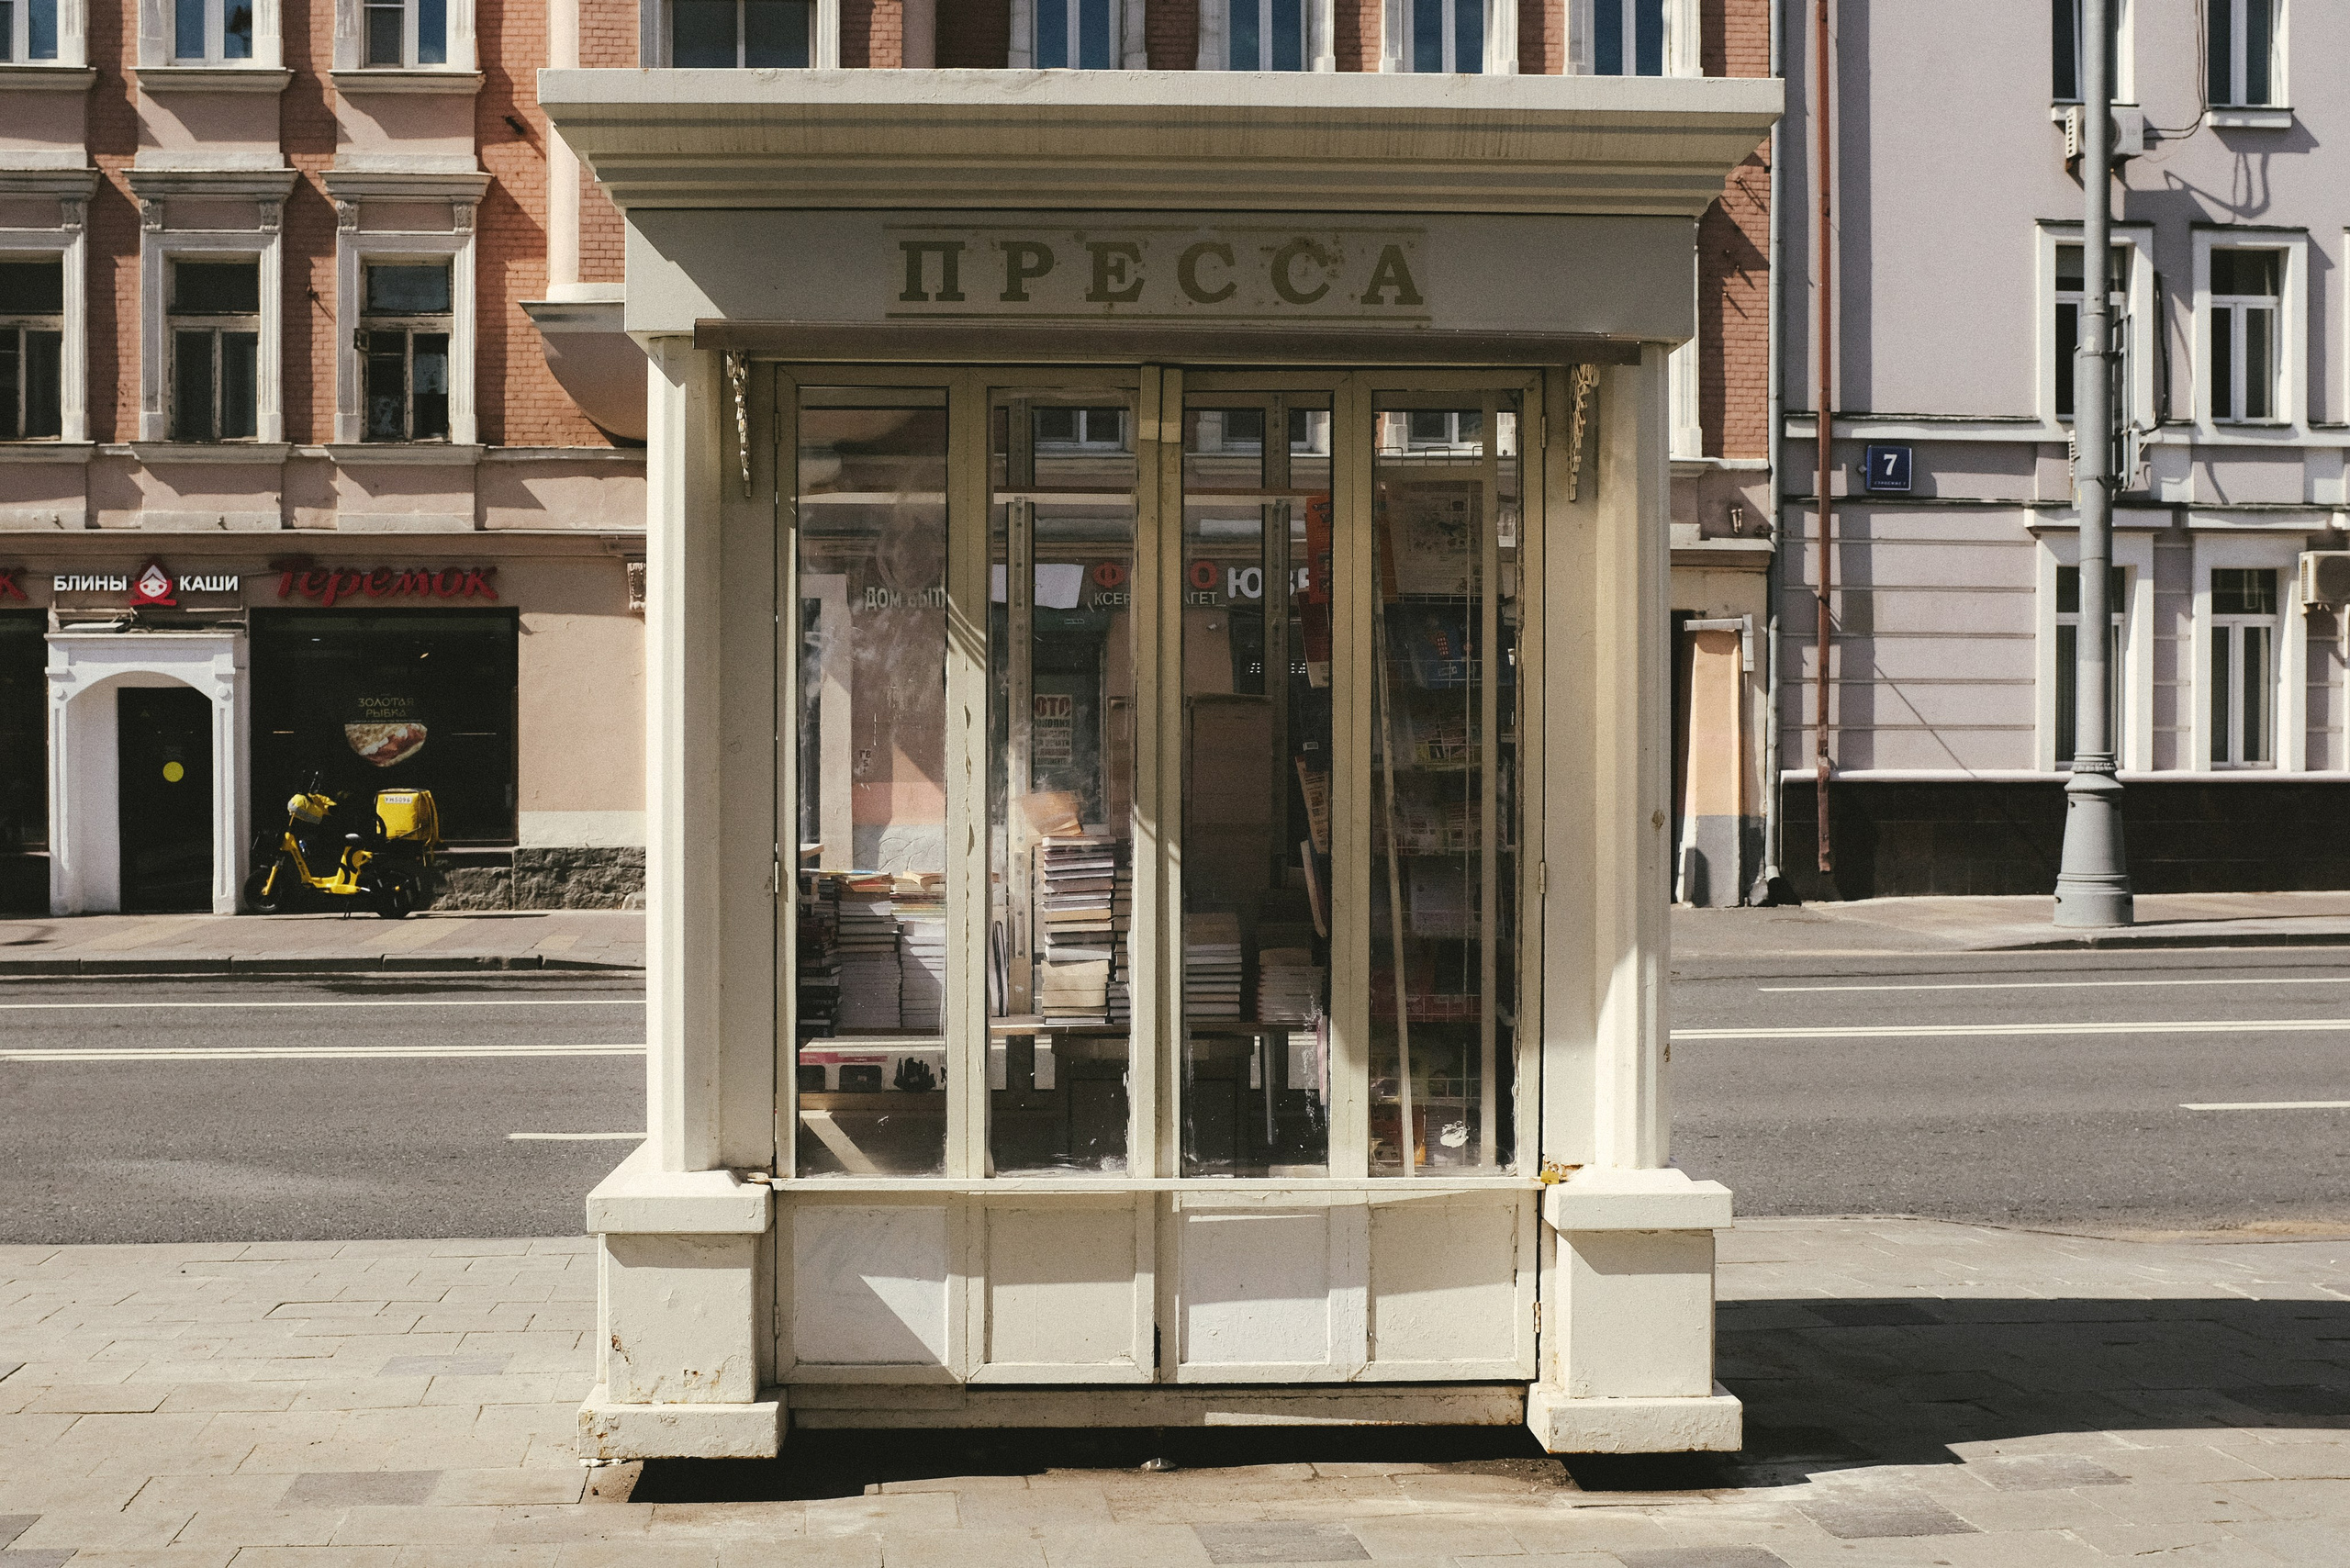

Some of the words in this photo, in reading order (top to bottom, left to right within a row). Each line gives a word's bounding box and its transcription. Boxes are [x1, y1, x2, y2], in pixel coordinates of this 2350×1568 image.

[898, 241, 1425, 306] ПРЕССА
[1884, 454, 1897, 476] 7
[53, 576, 128, 591] БЛИНЫ
[179, 576, 240, 591] КАШИ
[269, 553, 499, 608] Теремок
[865, 587, 901, 610] ДОМ
[908, 588, 946, 608] БЫТ
[1094, 592, 1131, 606] КСЕР
[1184, 591, 1218, 605] ГЕТ
[358, 698, 414, 707] ЗОЛОТАЯ
[365, 708, 407, 718] РЫБКА
[1035, 696, 1071, 717] ОТО
